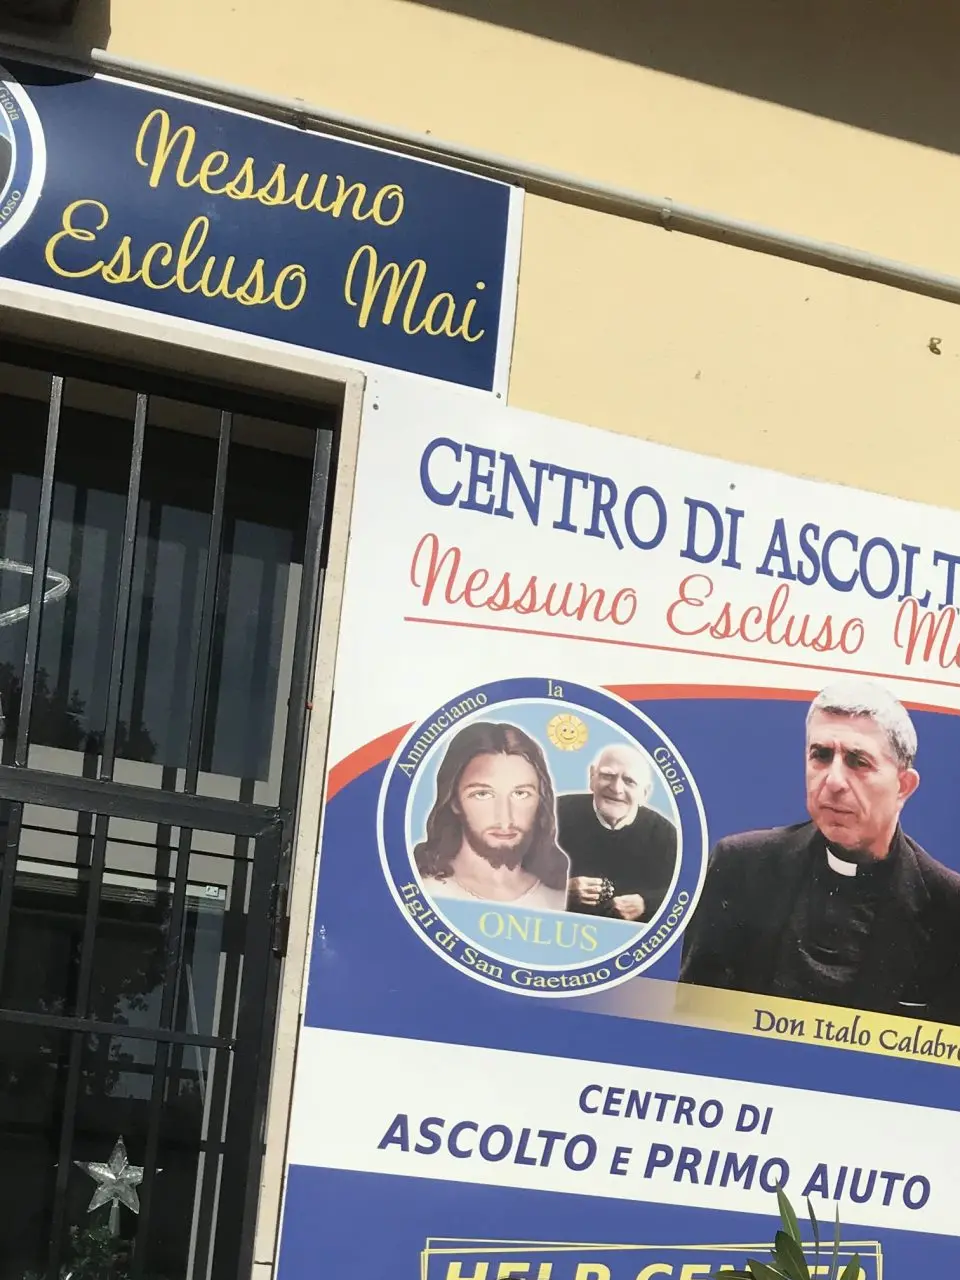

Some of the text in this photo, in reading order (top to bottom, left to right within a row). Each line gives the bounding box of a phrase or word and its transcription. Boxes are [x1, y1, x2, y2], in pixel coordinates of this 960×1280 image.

[135, 109, 404, 226] Nessuno
[45, 199, 485, 342] Escluso Mai
[419, 437, 667, 549] CENTRO
[680, 497, 745, 569] DI
[410, 533, 637, 626] Nessuno
[666, 573, 865, 655] Escluso
[397, 680, 686, 796] Annunciamo la Gioia
[399, 881, 690, 989] figli di San Gaetano Catanoso
[478, 911, 599, 952] ONLUS
[752, 1008, 806, 1037] Don
[812, 1015, 872, 1047] Italo
[377, 1113, 931, 1211] ASCOLTO E PRIMO AIUTO
[578, 1083, 774, 1136] CENTRO DI
